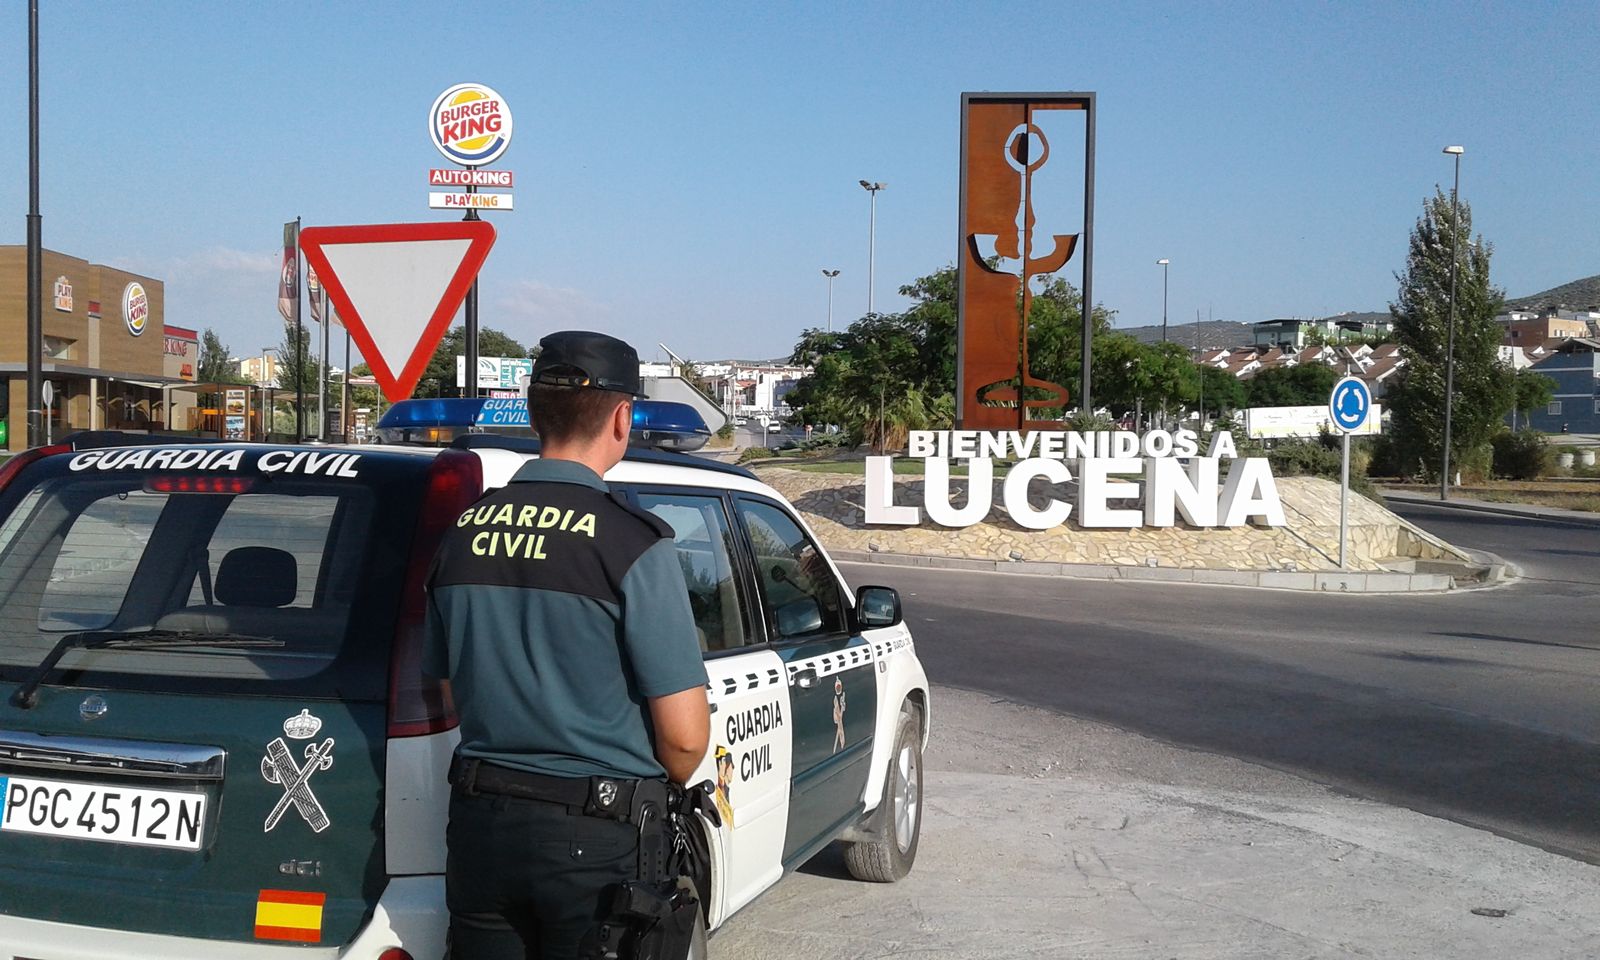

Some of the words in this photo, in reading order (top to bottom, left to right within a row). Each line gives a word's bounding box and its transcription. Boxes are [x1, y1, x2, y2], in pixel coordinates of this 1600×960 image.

[441, 100, 500, 125] BURGER
[443, 113, 502, 144] KING
[431, 170, 511, 185] AUTOKING
[445, 194, 498, 207] PLAYKING
[58, 284, 72, 298] PLAY
[129, 294, 146, 310] BURGER
[130, 302, 147, 321] KING
[170, 339, 187, 357] KING
[492, 411, 528, 423] CIVIL
[908, 429, 1199, 459] BIENVENIDOS
[1210, 430, 1238, 459] A
[69, 449, 246, 472] GUARDIA
[256, 451, 362, 478] CIVIL
[864, 455, 1287, 530] LUCENA
[456, 503, 597, 538] GUARDIA
[471, 531, 547, 560] CIVIL
[726, 700, 783, 746] GUARDIA
[740, 743, 772, 782] CIVIL
